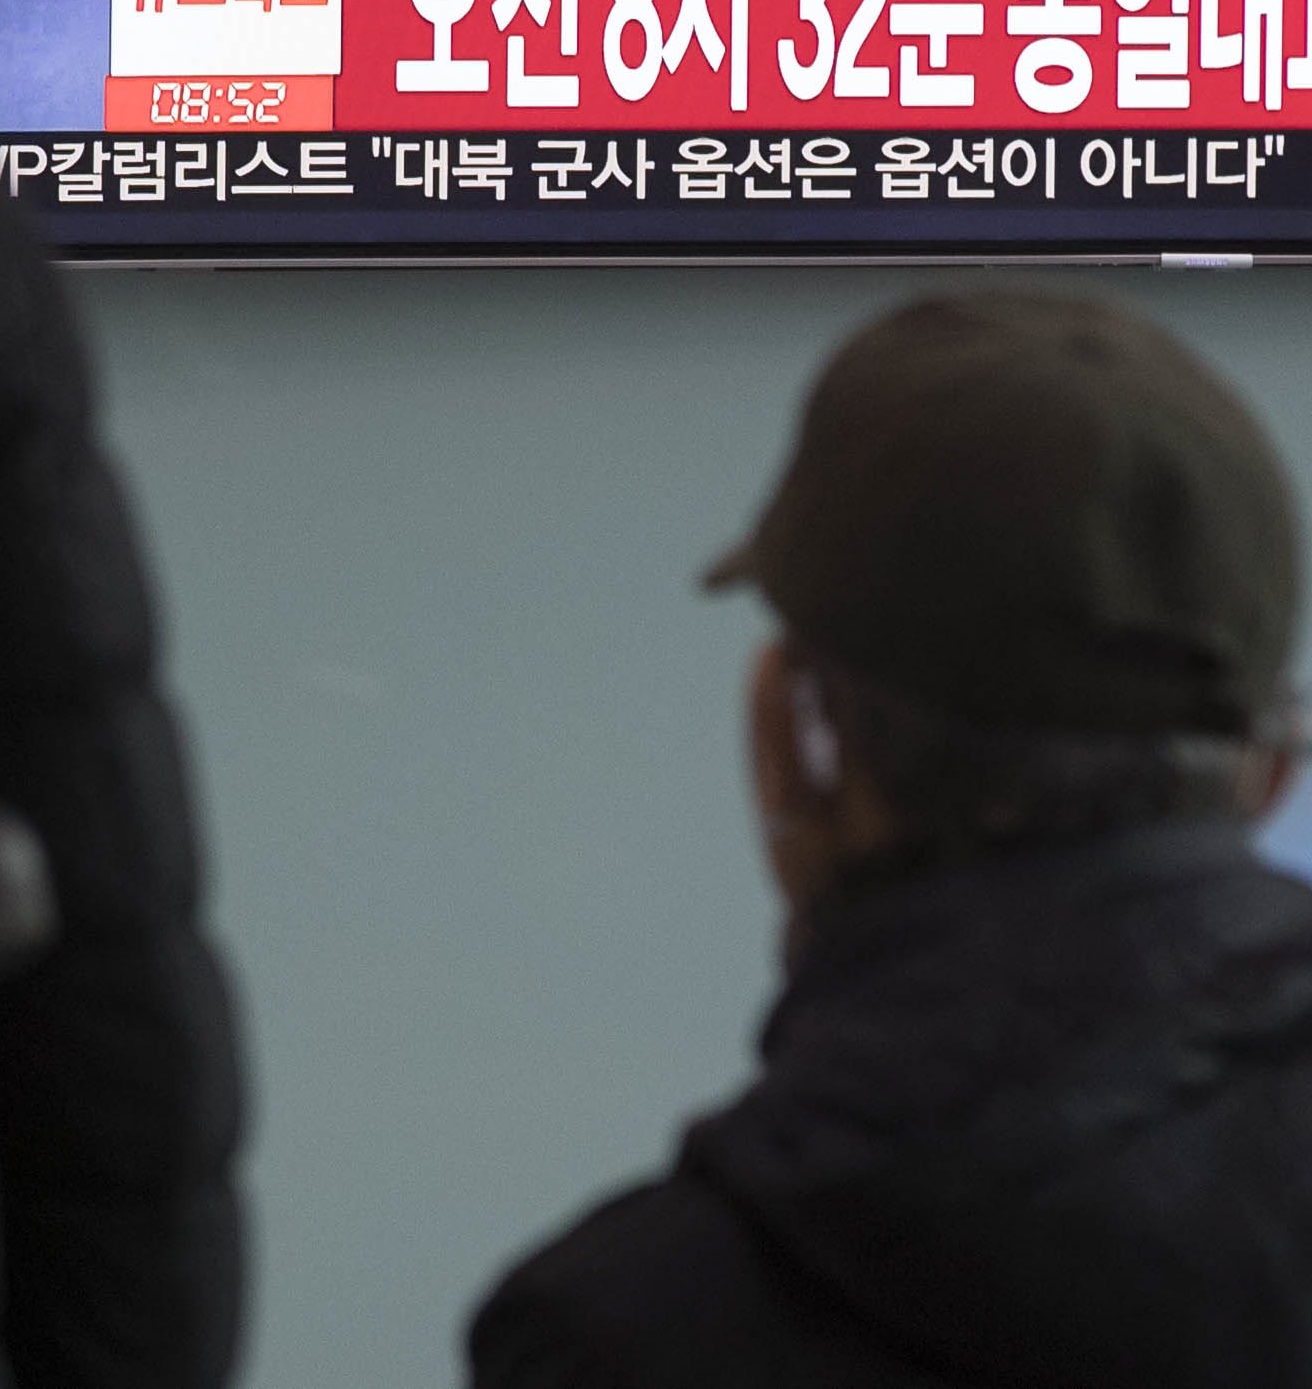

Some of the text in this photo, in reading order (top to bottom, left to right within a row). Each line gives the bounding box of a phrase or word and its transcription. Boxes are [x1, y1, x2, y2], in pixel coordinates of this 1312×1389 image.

[150, 81, 287, 124] 08:52
[370, 136, 514, 200] "대북
[530, 137, 655, 200] 군사
[670, 137, 858, 199] 옵션은
[873, 137, 1057, 199] 옵션이
[1079, 135, 1285, 199] 아니다"
